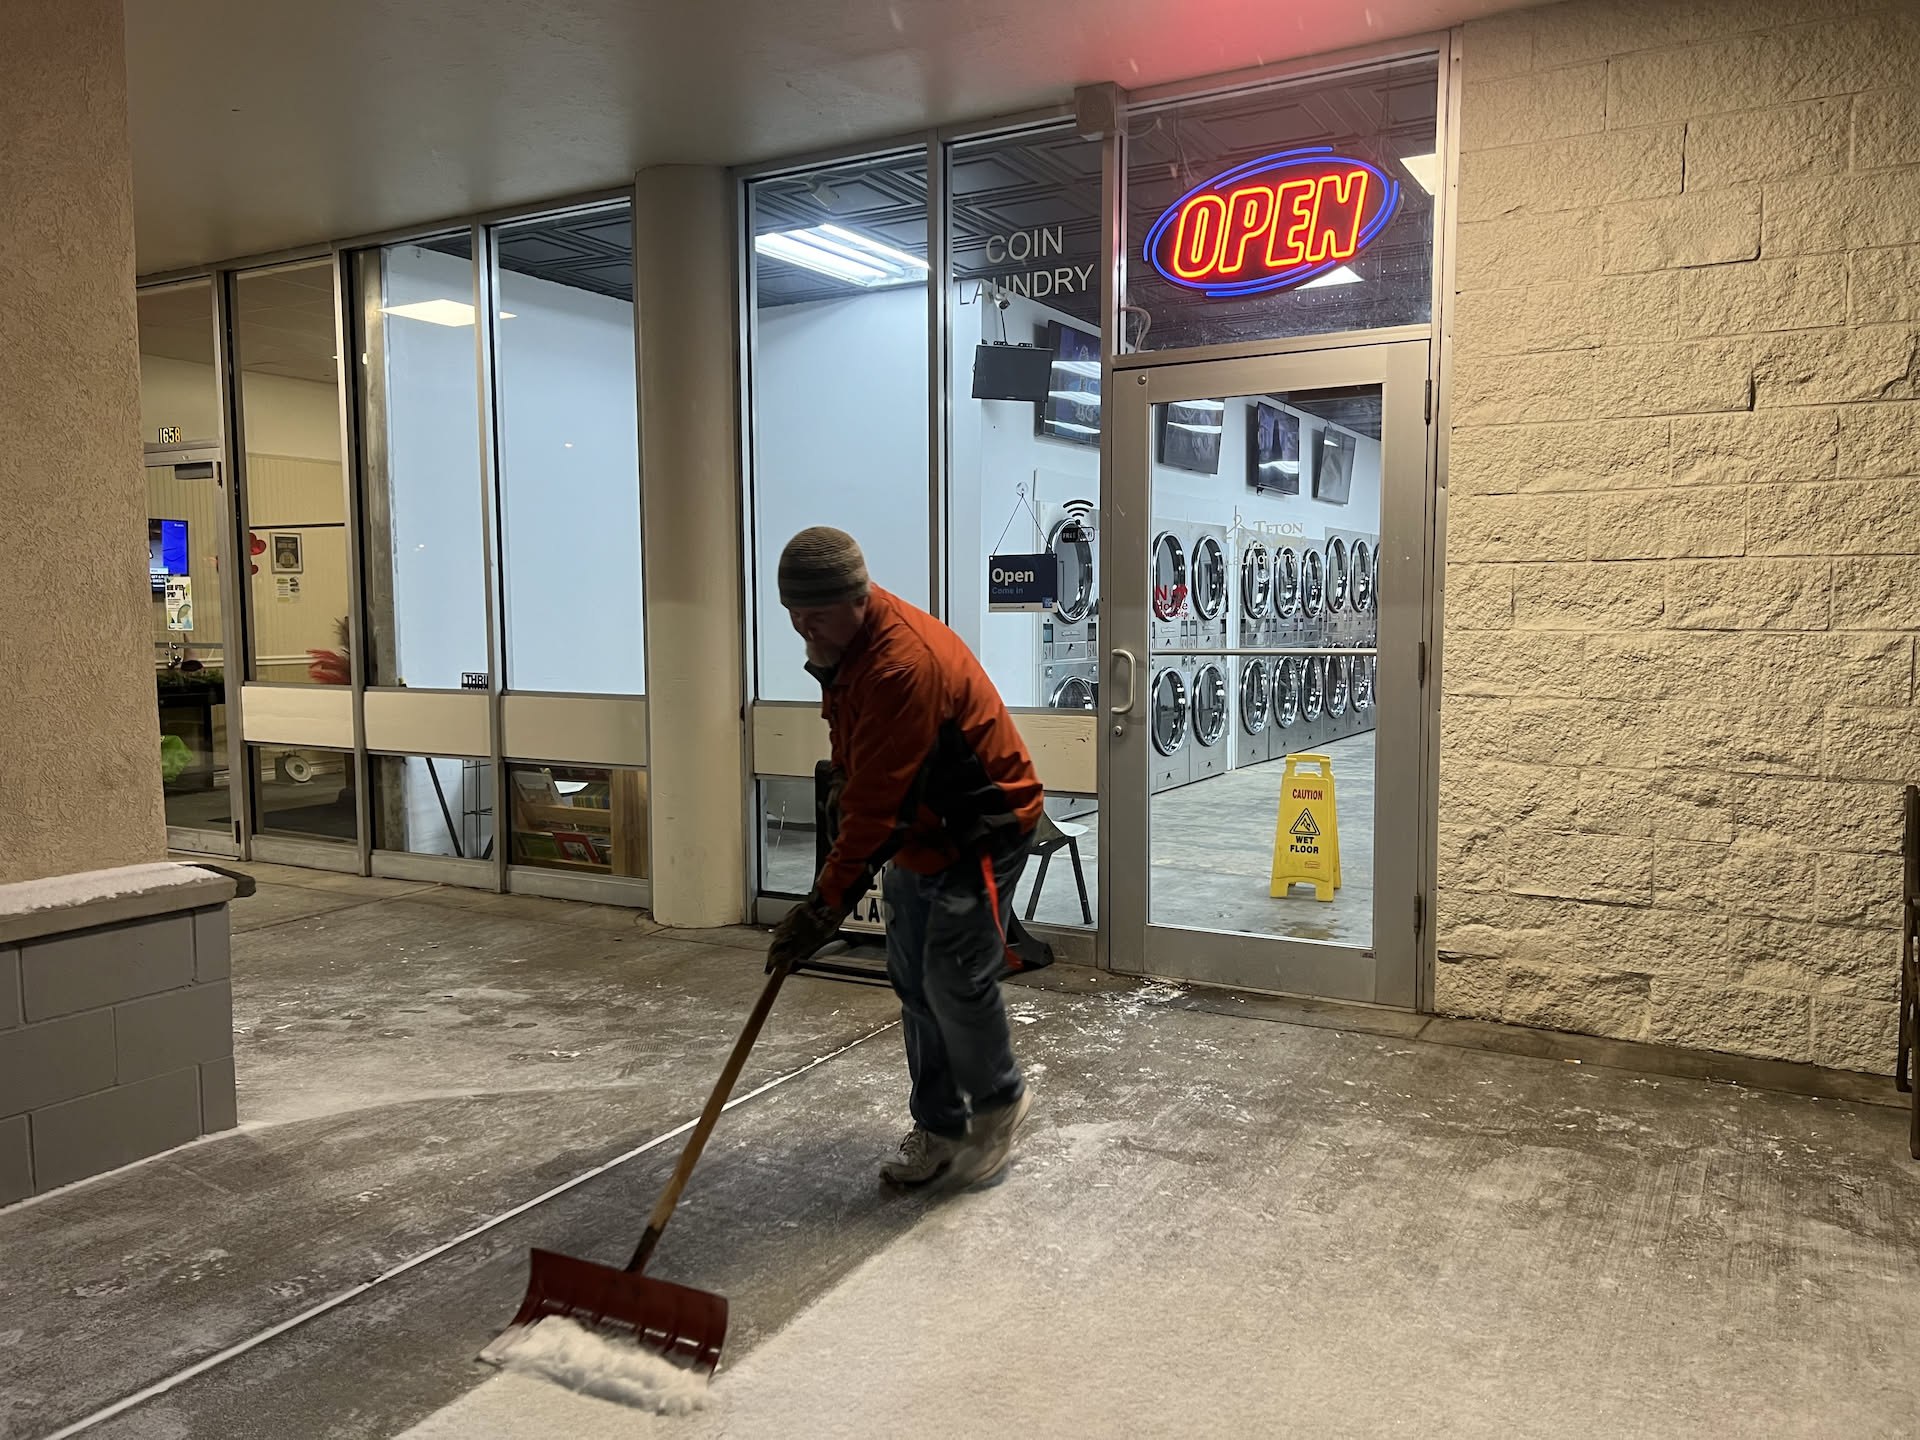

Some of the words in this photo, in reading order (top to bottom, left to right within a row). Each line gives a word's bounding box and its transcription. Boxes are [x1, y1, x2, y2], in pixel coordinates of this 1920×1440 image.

[1173, 170, 1370, 279] OPEN
[985, 226, 1064, 263] COIN
[959, 263, 1095, 306] LAUNDRY
[159, 427, 181, 443] 1658
[991, 567, 1034, 586] Open
[991, 586, 1014, 595] Come
[465, 674, 488, 685] THRI
[1292, 788, 1323, 800] CAUTION
[1295, 836, 1315, 845] WET
[1290, 845, 1319, 854] FLOOR
